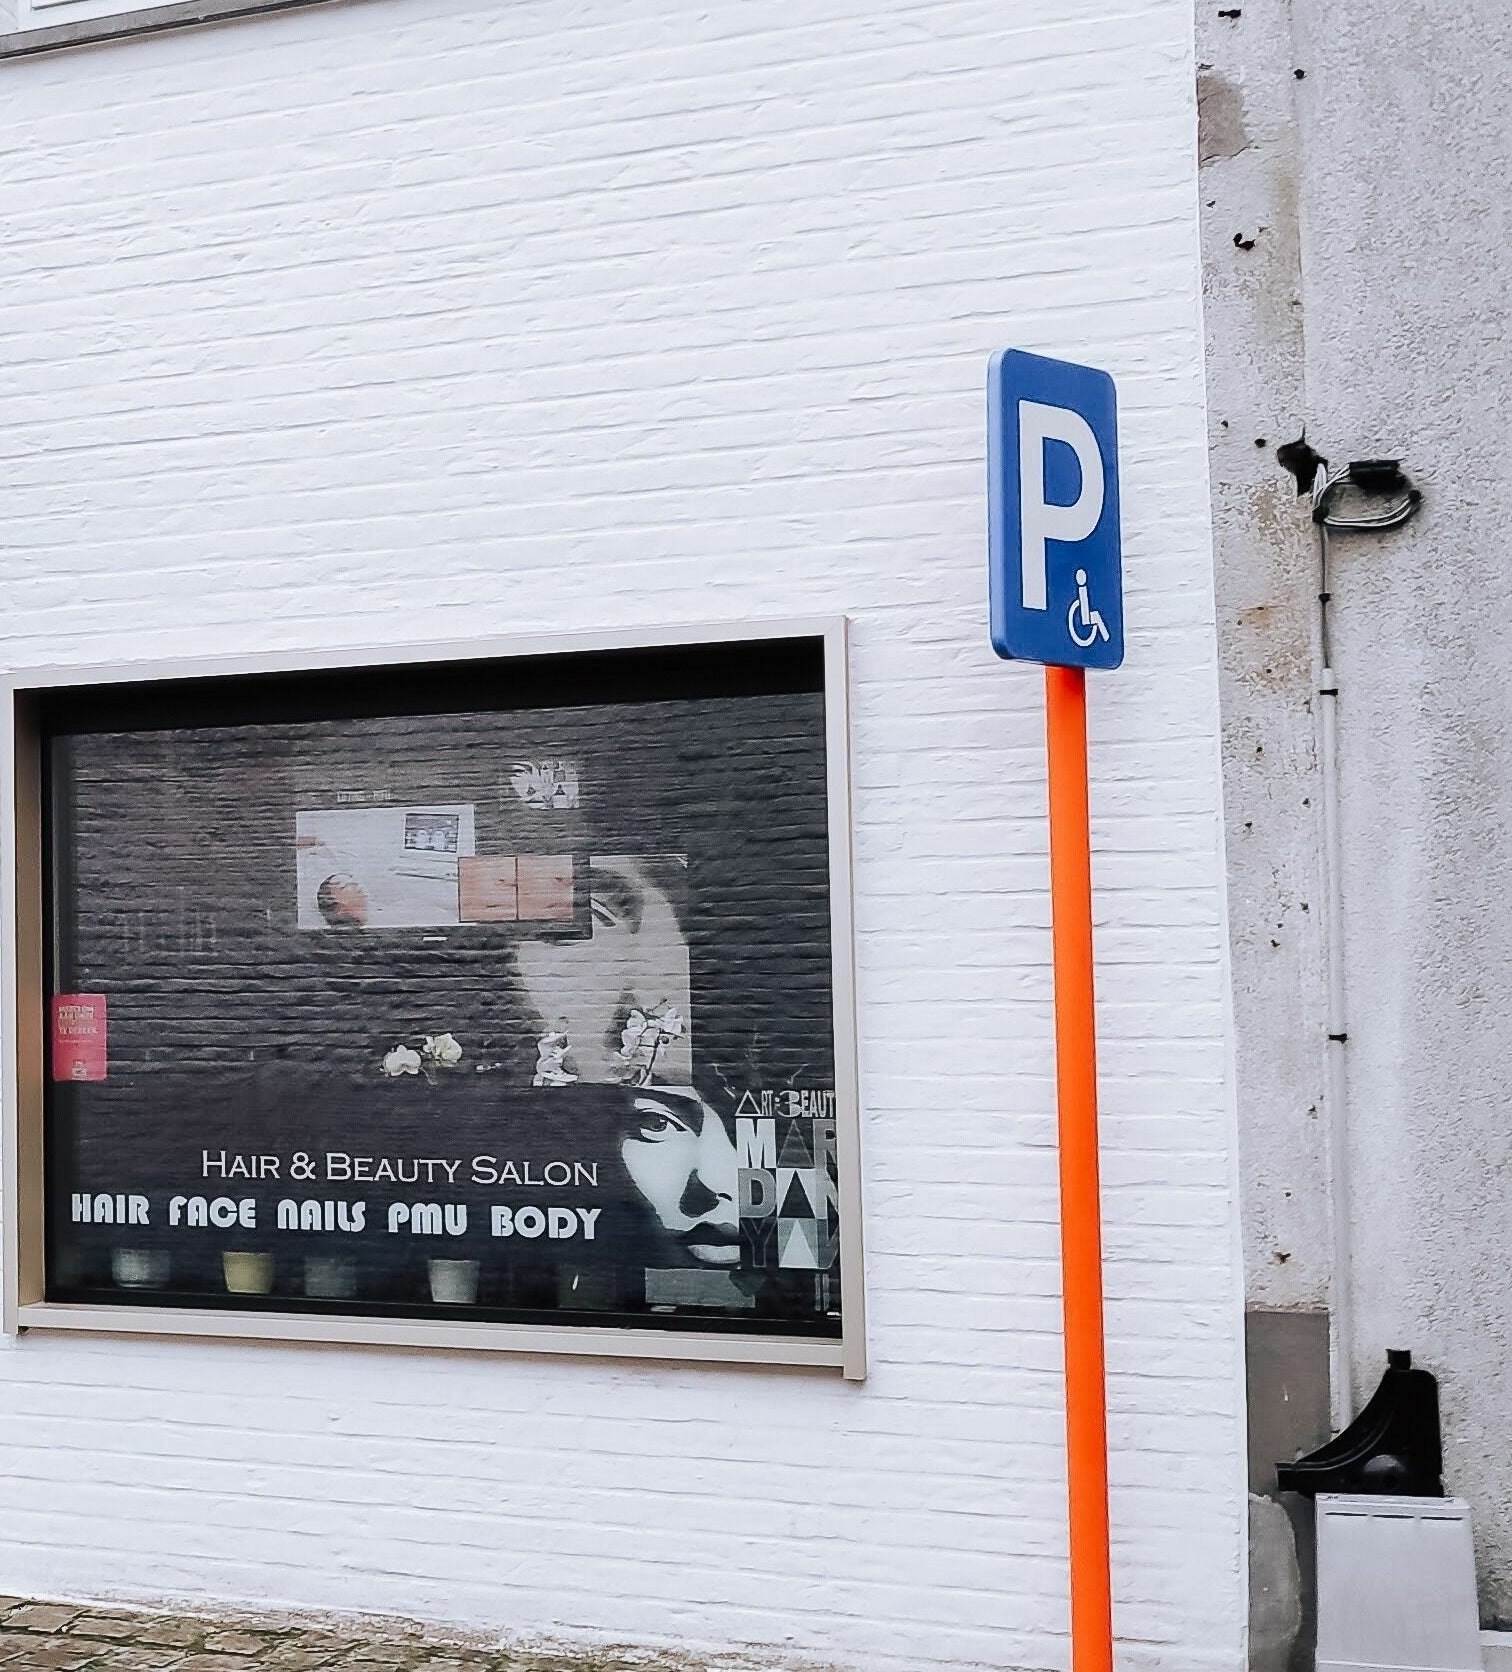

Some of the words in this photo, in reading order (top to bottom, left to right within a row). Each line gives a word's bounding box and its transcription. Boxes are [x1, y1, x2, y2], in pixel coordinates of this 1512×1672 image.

[1018, 399, 1105, 611] P
[776, 1089, 836, 1118] BEAUT
[201, 1149, 281, 1180] HAIR
[289, 1152, 316, 1181] &
[324, 1152, 462, 1184] BEAUTY
[470, 1154, 600, 1187] SALON
[71, 1193, 150, 1226] HAIR
[168, 1195, 257, 1229] FACE
[276, 1198, 366, 1233] NAILS
[388, 1202, 468, 1236] PMU
[490, 1206, 602, 1240] BODY
